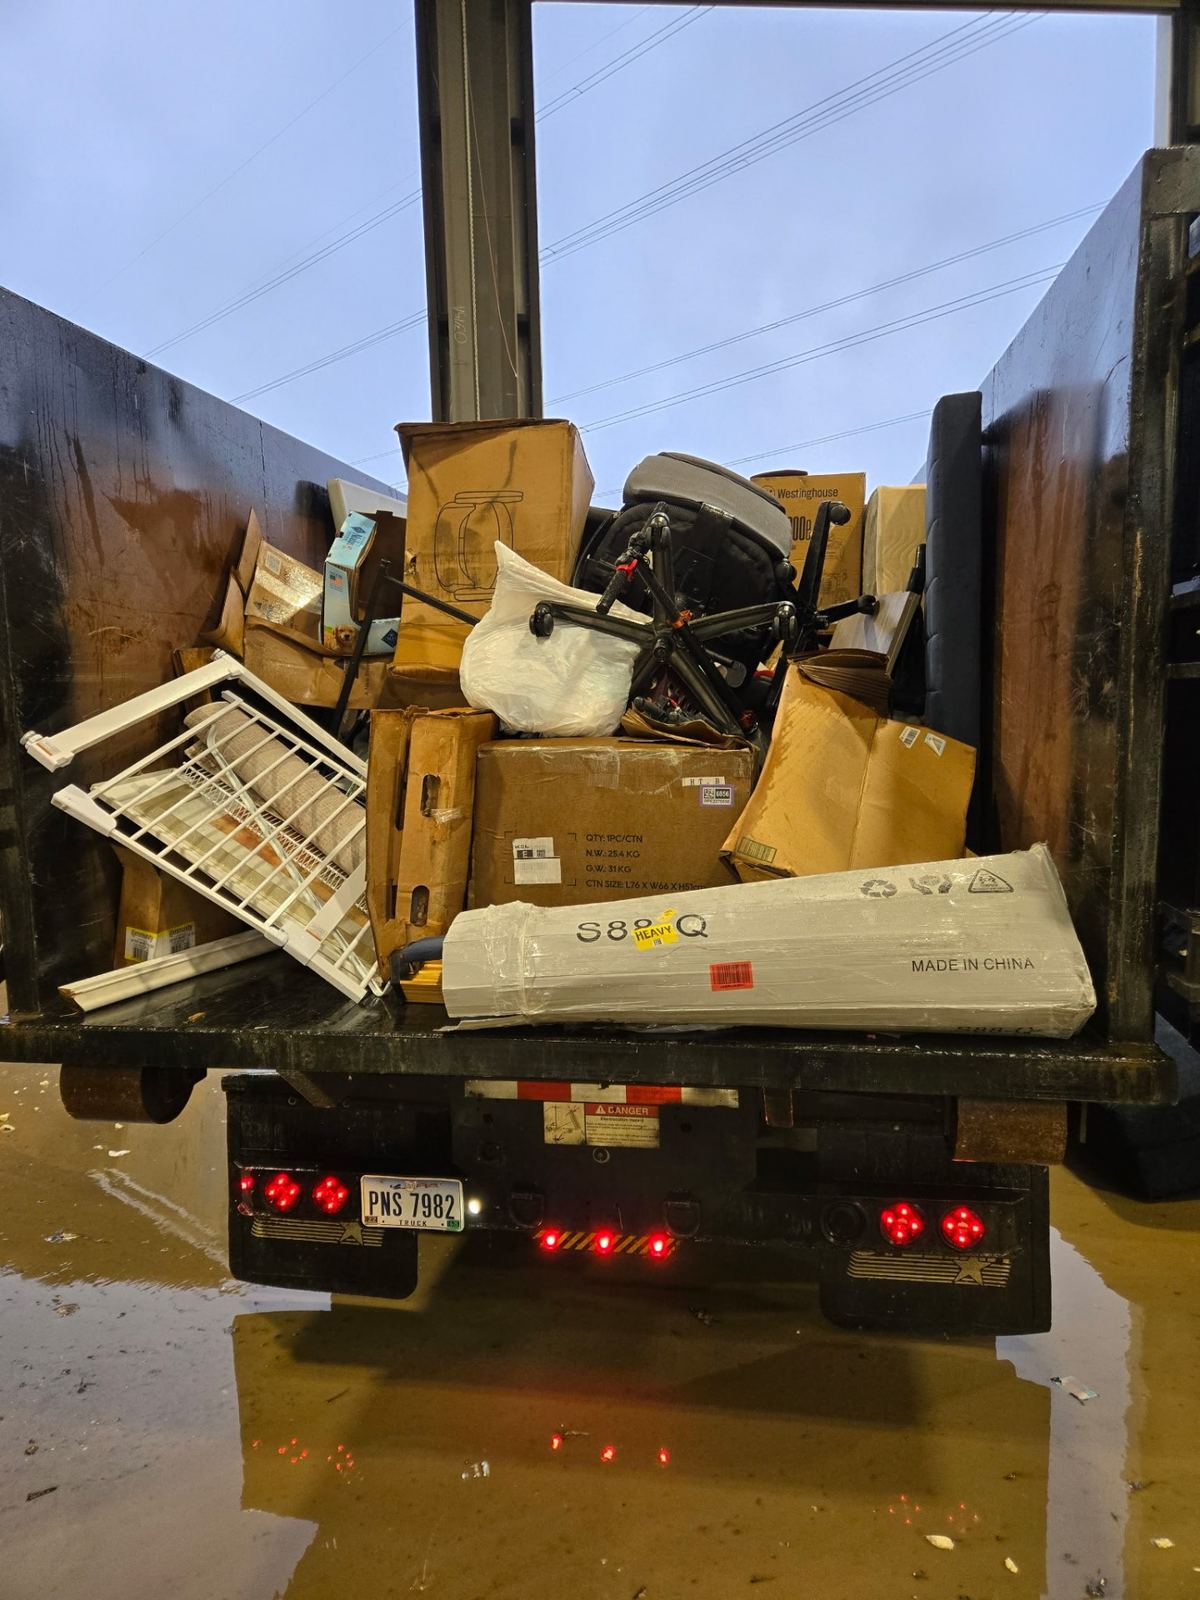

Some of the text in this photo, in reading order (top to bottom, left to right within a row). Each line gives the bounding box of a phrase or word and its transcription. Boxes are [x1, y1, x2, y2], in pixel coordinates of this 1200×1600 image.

[777, 487, 839, 500] Westinghouse
[788, 515, 812, 541] 00e
[585, 833, 606, 842] QTY:
[626, 850, 640, 858] KG
[585, 879, 603, 888] CTN
[642, 881, 648, 890] X
[649, 881, 669, 890] W66
[671, 882, 678, 890] X
[635, 925, 672, 941] HEAVY
[911, 957, 1035, 972] MADE IN CHINA
[608, 1106, 649, 1116] DANGER
[368, 1191, 455, 1220] PNS 7982
